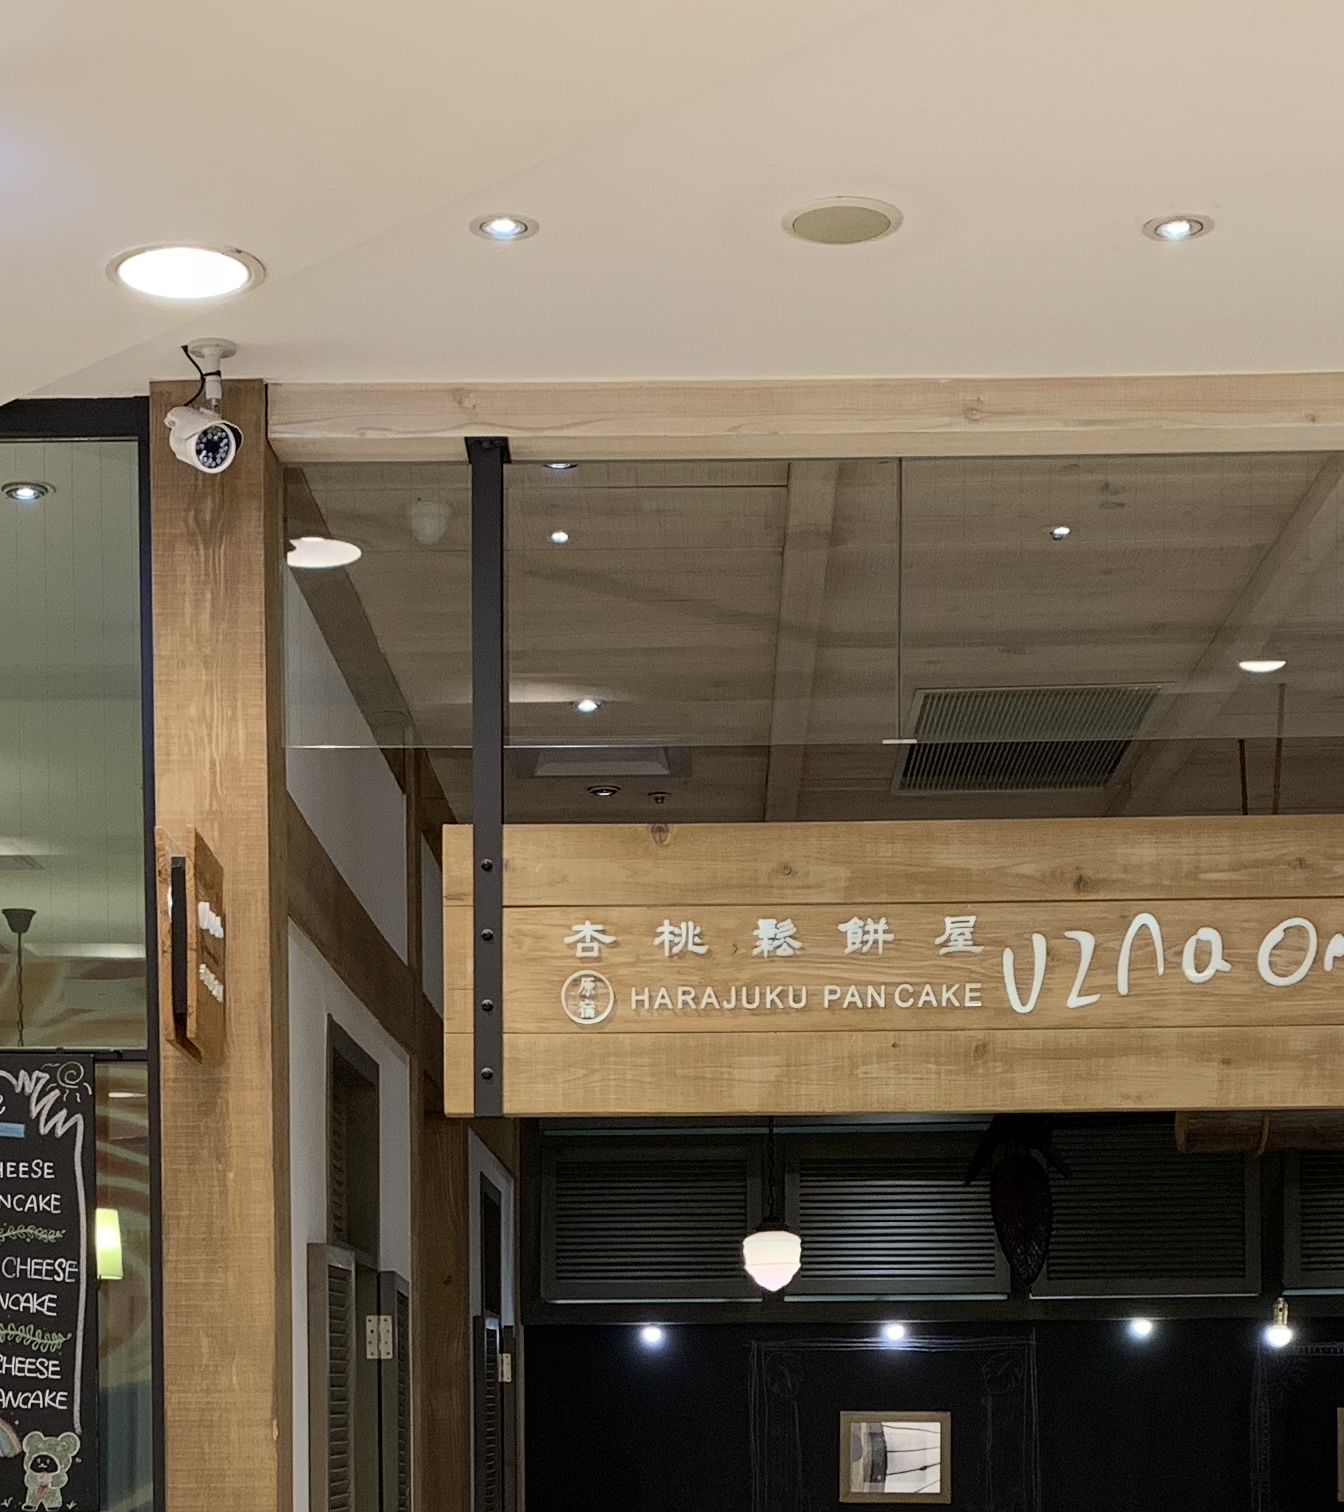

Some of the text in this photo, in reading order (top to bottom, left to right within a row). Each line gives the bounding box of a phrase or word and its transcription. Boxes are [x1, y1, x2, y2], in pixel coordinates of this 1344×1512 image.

[563, 915, 985, 958] 杏桃鬆餅屋
[630, 983, 982, 1010] HARAJUKU PANCAKE
[1, 1256, 79, 1283] CHEESE
